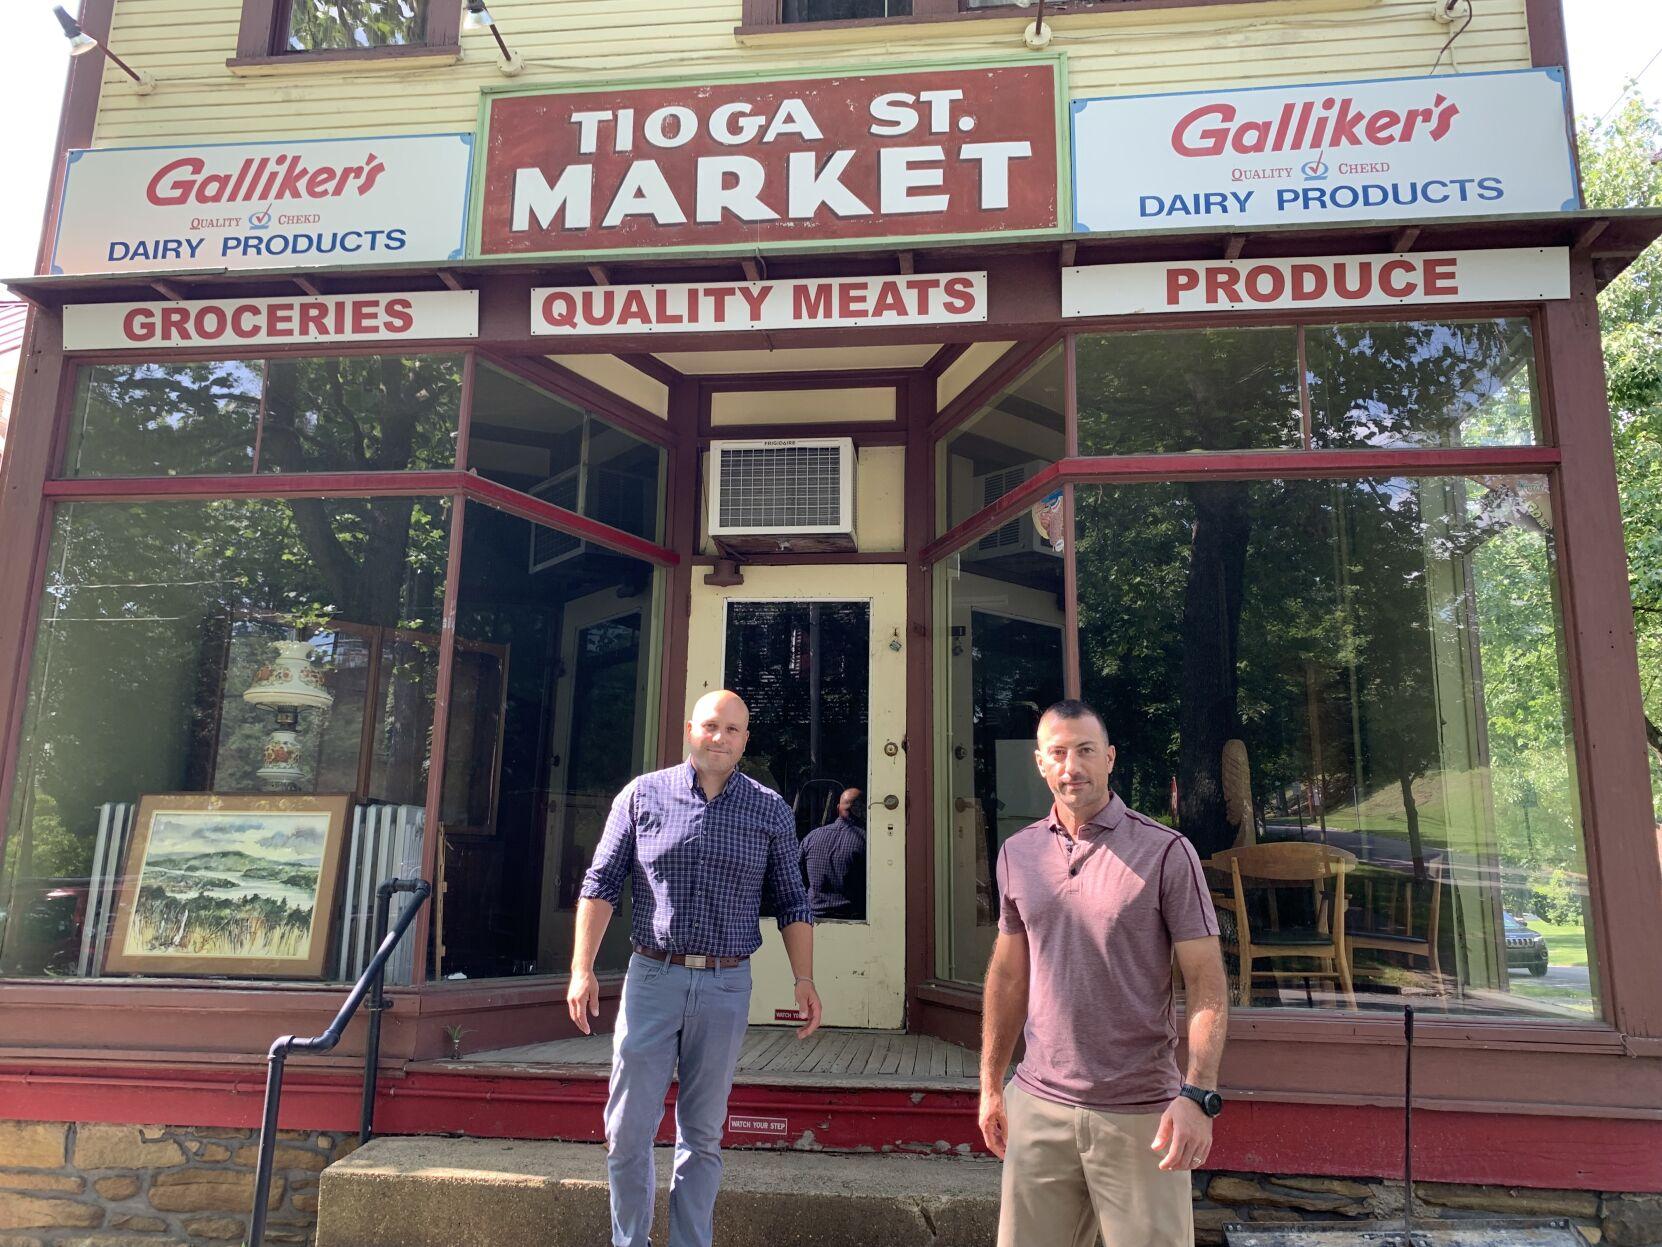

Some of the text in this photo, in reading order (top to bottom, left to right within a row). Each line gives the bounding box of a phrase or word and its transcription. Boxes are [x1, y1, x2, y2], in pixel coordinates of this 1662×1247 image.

[570, 89, 975, 155] TIOGA ST.
[1172, 94, 1459, 158] Galliker's
[147, 152, 385, 207] Galliker's
[511, 140, 1032, 233] MARKET
[1231, 162, 1391, 182] QUALITY CHEKD
[1139, 176, 1505, 218] DAIRY PRODUCTS
[189, 214, 320, 230] QUALITY CHEKD
[107, 229, 407, 262] DAIRY PRODUCTS
[541, 276, 977, 329] QUALITY MEATS
[1166, 258, 1459, 305] PRODUCE
[123, 298, 414, 342] GROCERIES
[731, 1120, 786, 1130] WATCH YOUR STEP
